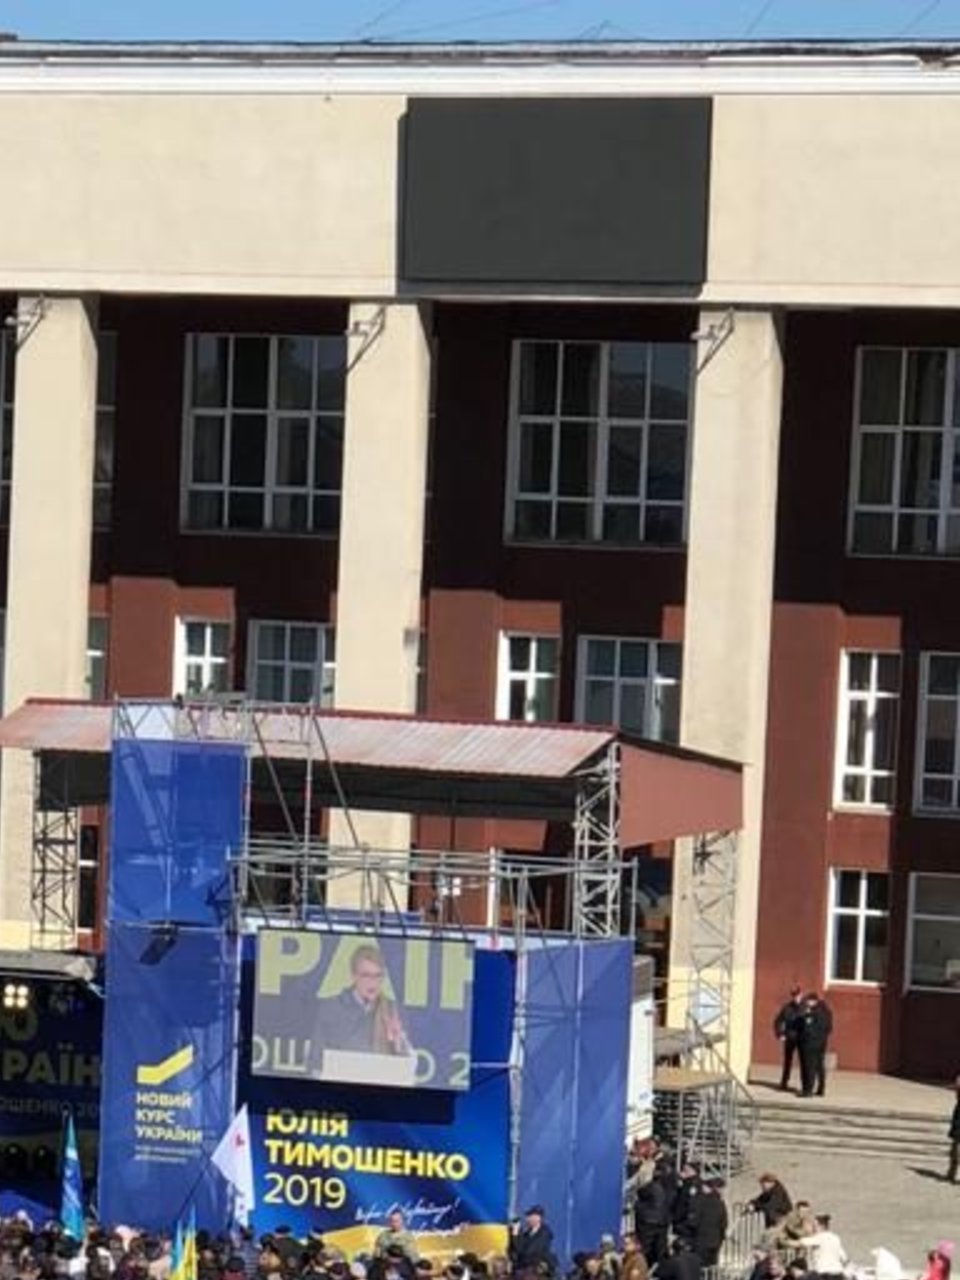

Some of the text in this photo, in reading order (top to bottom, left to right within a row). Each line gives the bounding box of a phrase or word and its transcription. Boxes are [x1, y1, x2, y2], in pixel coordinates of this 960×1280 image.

[136, 1091, 192, 1108] НОВИЙ
[135, 1108, 177, 1124] КУРС
[266, 1107, 349, 1138] ЮЛІЯ
[264, 1139, 471, 1181] ТИМОШЕНКО
[263, 1172, 347, 1209] 2019
